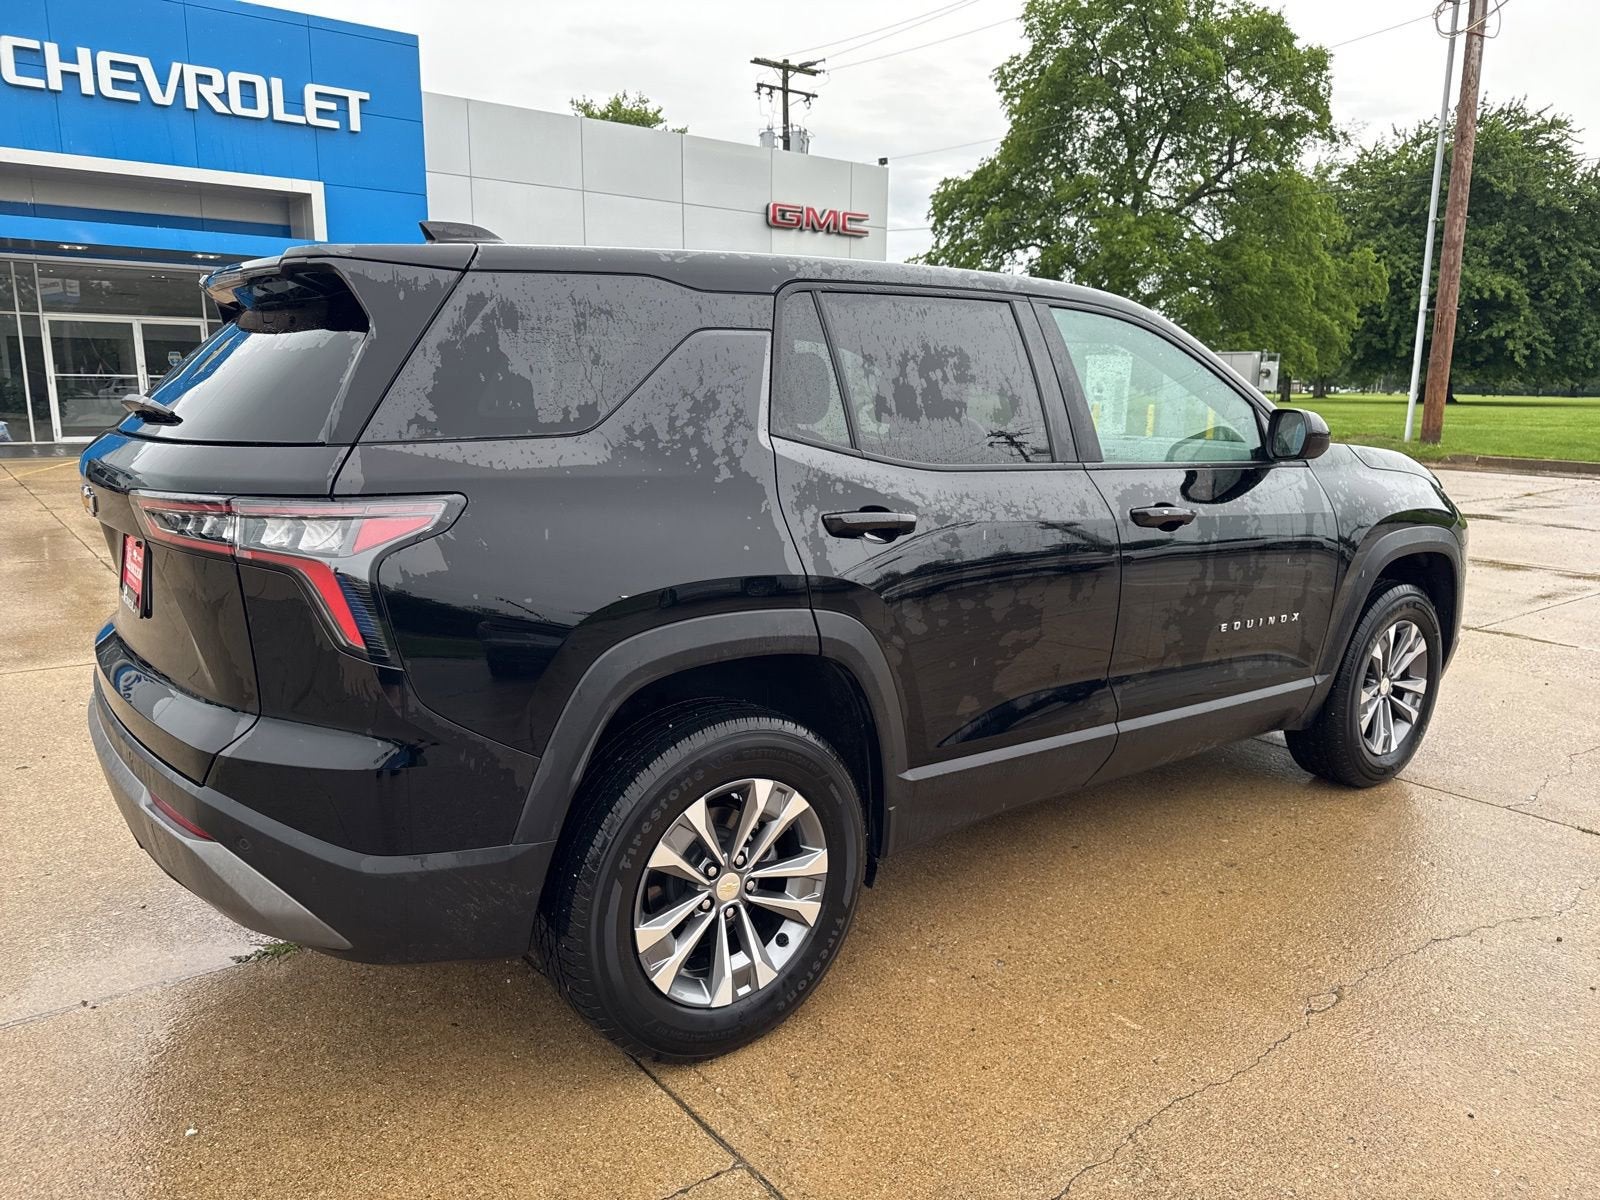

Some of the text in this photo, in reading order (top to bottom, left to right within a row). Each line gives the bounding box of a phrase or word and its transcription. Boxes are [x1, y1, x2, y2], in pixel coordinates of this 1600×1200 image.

[0, 35, 370, 132] CHEVROLET
[766, 202, 869, 237] GMC
[1220, 612, 1300, 632] EQUINOX
[620, 768, 705, 871] Firestone
[776, 916, 846, 1011] Firestone
